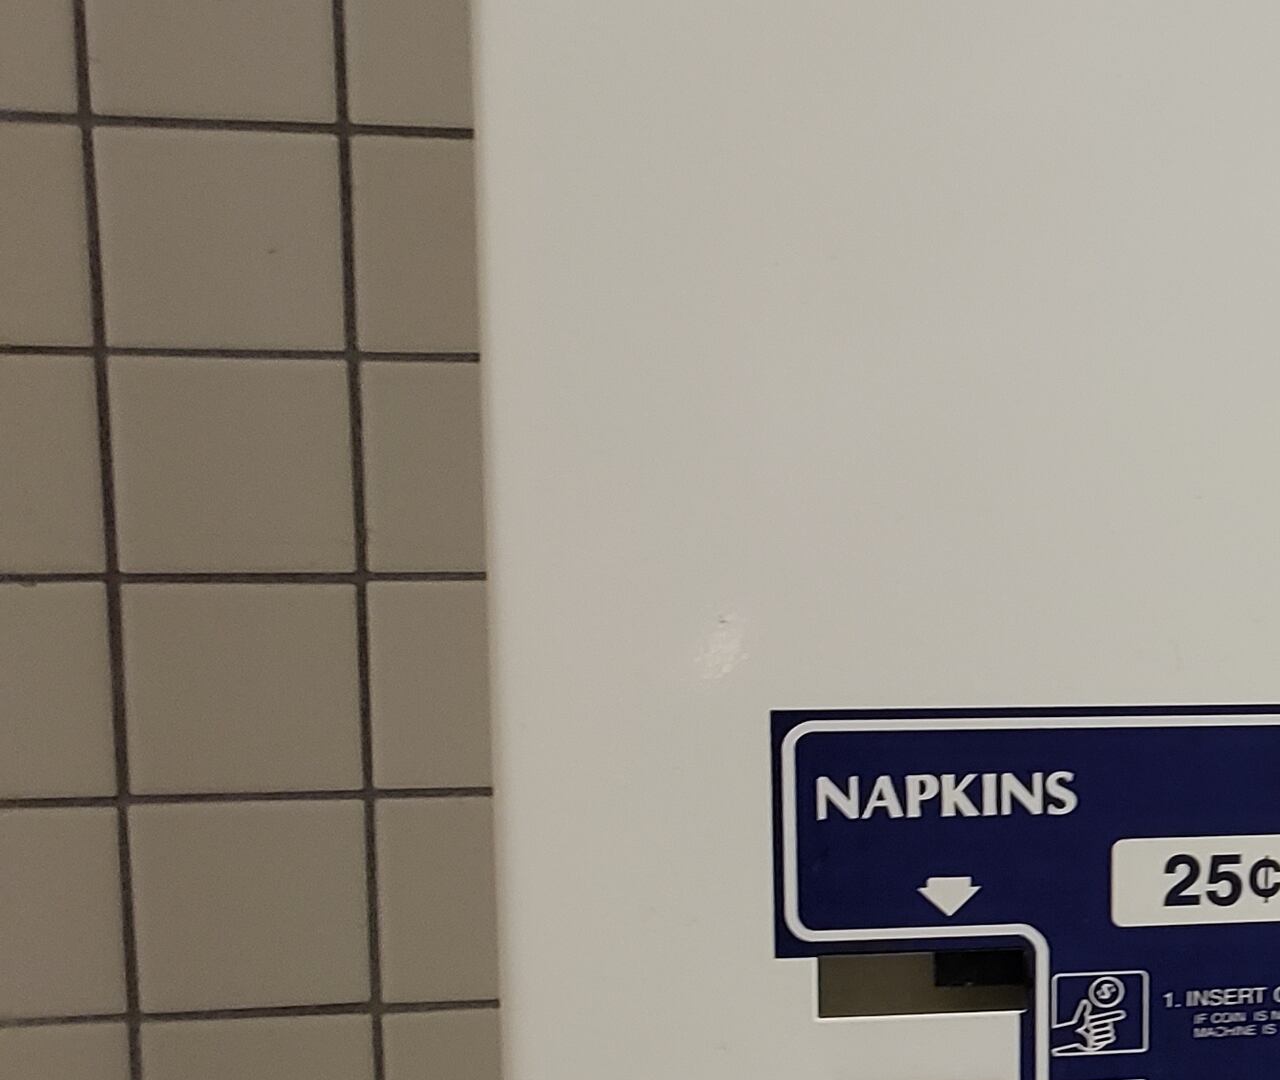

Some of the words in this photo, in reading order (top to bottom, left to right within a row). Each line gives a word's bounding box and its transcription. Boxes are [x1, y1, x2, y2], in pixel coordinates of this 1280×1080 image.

[815, 771, 1078, 822] NAPKINS
[1163, 992, 1182, 1009] 1.
[1185, 986, 1268, 1008] INSERT
[1193, 1012, 1209, 1025] IF
[1210, 1011, 1248, 1024] COIN
[1253, 1010, 1269, 1022] IS
[1193, 1023, 1257, 1039] MACHINE
[1261, 1022, 1277, 1035] IS
